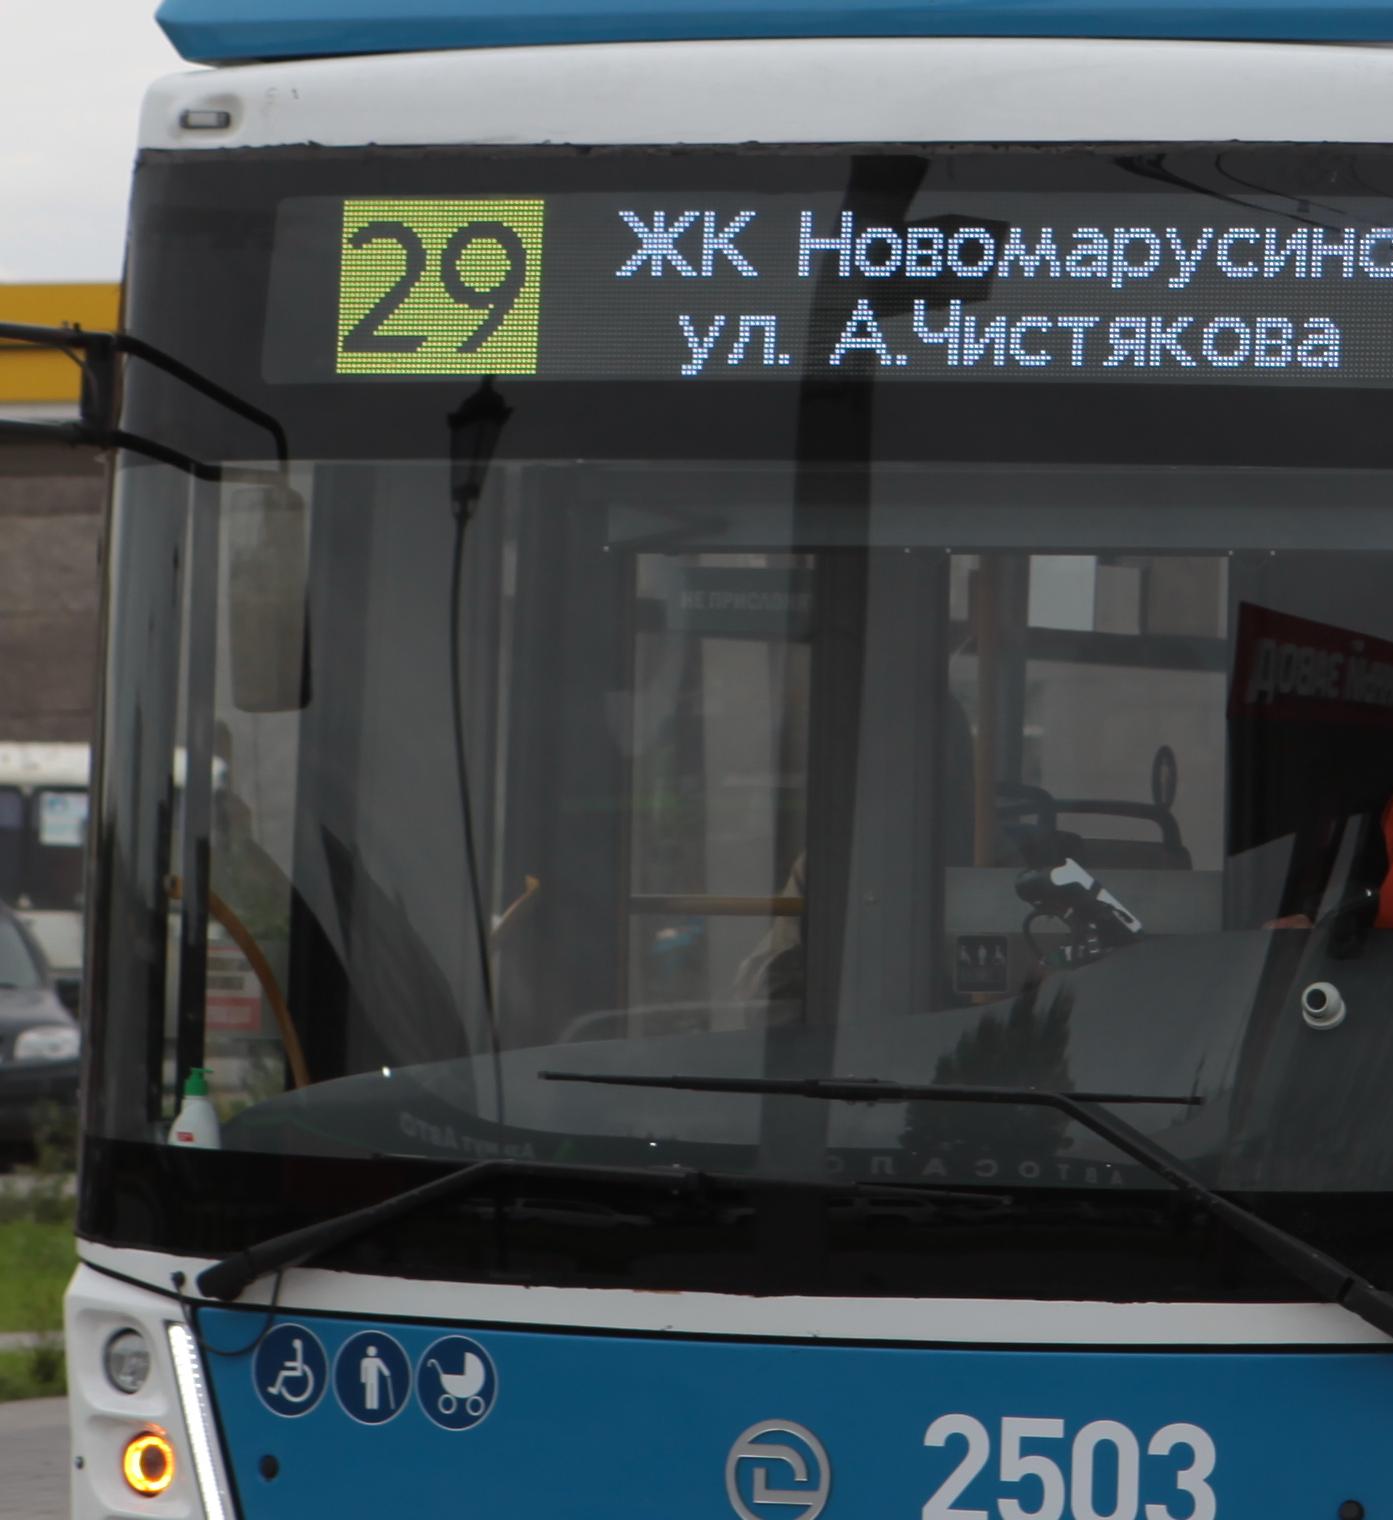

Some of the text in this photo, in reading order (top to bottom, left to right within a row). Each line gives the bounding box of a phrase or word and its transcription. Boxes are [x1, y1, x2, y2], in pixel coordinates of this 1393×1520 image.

[343, 221, 528, 354] 29
[616, 210, 758, 278] ЖК
[678, 298, 1342, 376] ул. А.Чистякова
[921, 1413, 1218, 1520] 2503
